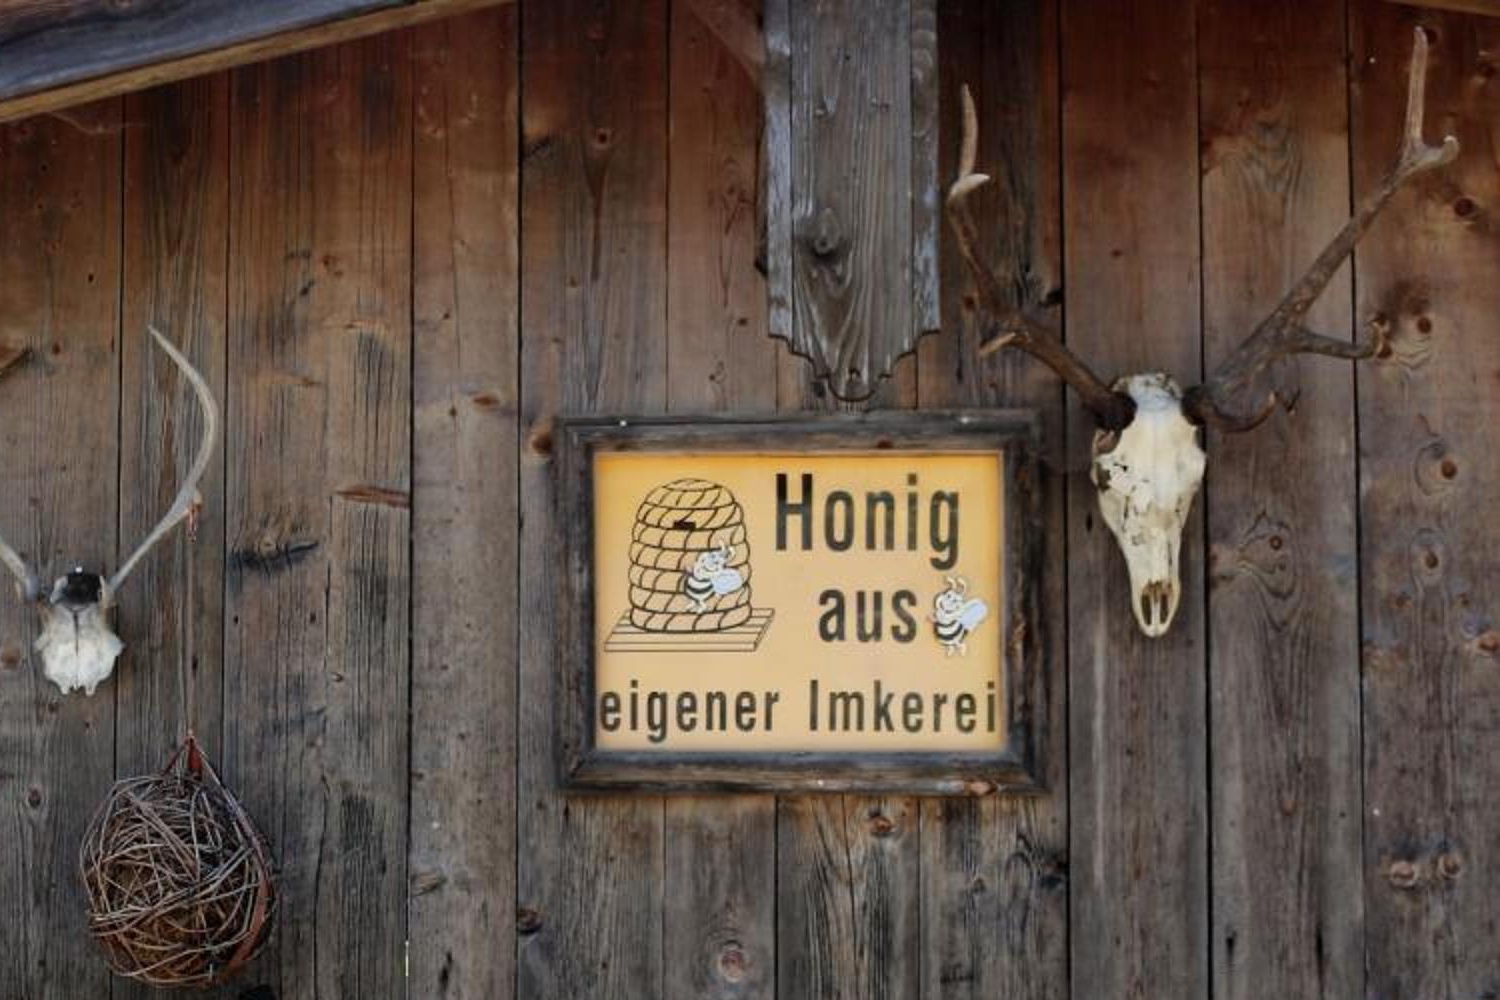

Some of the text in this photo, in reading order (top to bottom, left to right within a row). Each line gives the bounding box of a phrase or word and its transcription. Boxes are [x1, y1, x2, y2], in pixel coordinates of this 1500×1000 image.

[775, 473, 960, 570] Honig
[818, 587, 918, 643] aus
[600, 679, 996, 744] eigener Imkerei
